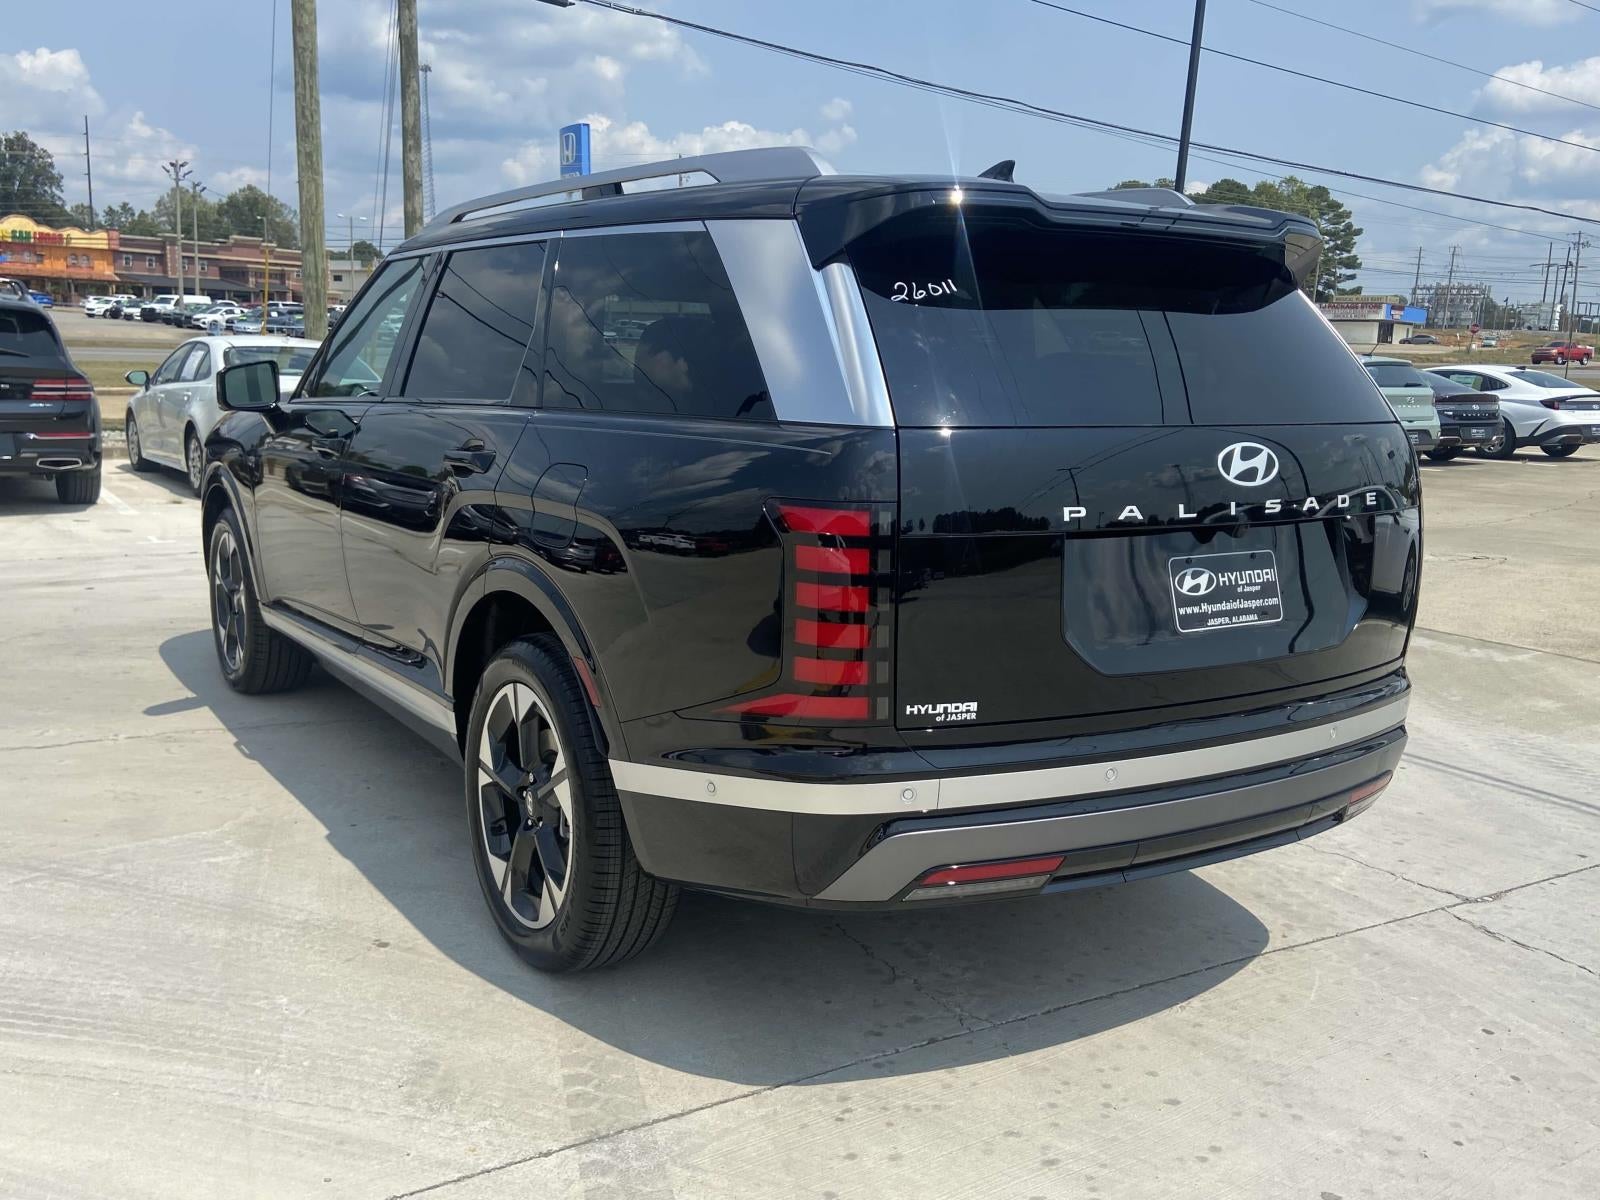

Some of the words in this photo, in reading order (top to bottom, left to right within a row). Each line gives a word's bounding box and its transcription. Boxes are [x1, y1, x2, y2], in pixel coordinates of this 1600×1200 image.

[891, 278, 958, 302] 26011
[1063, 492, 1377, 522] PALISADE
[1218, 568, 1276, 587] HYUNDAI
[1243, 585, 1261, 593] Jasper
[1178, 597, 1279, 615] www.HyundaiofJasper.com
[1207, 616, 1231, 626] JASPER,
[1232, 613, 1258, 623] ALABAMA
[906, 701, 978, 715] HYUNDAI
[936, 713, 945, 722] of
[946, 712, 977, 721] JASPER
